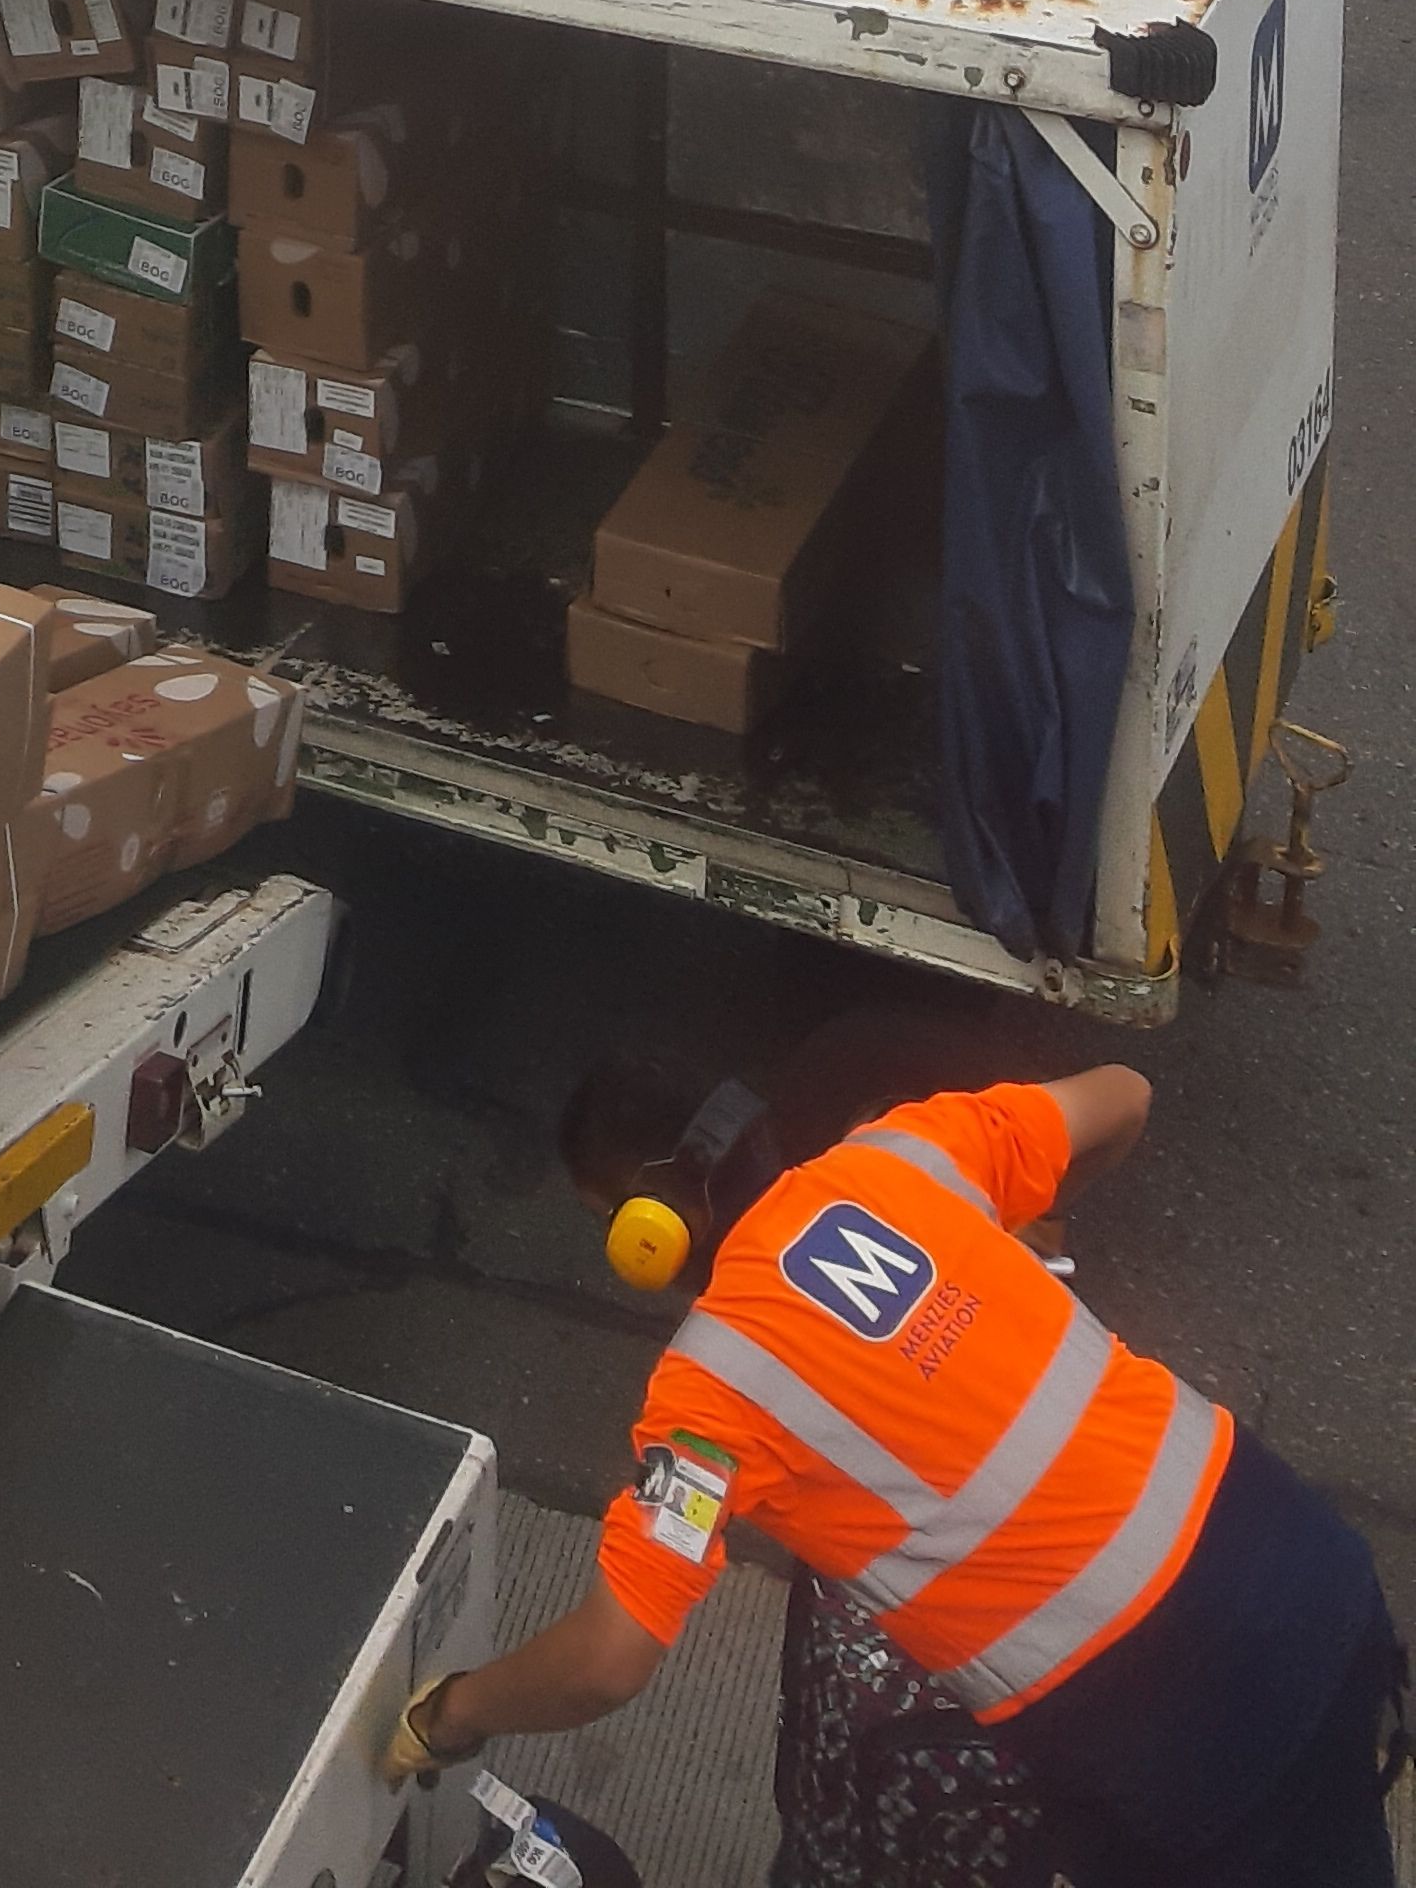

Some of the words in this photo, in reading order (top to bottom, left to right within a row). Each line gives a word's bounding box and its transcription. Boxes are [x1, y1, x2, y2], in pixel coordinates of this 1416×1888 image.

[1253, 27, 1280, 166] M
[808, 1225, 919, 1324] M
[898, 1279, 962, 1362] MENZIES
[917, 1291, 984, 1383] AVIATION
